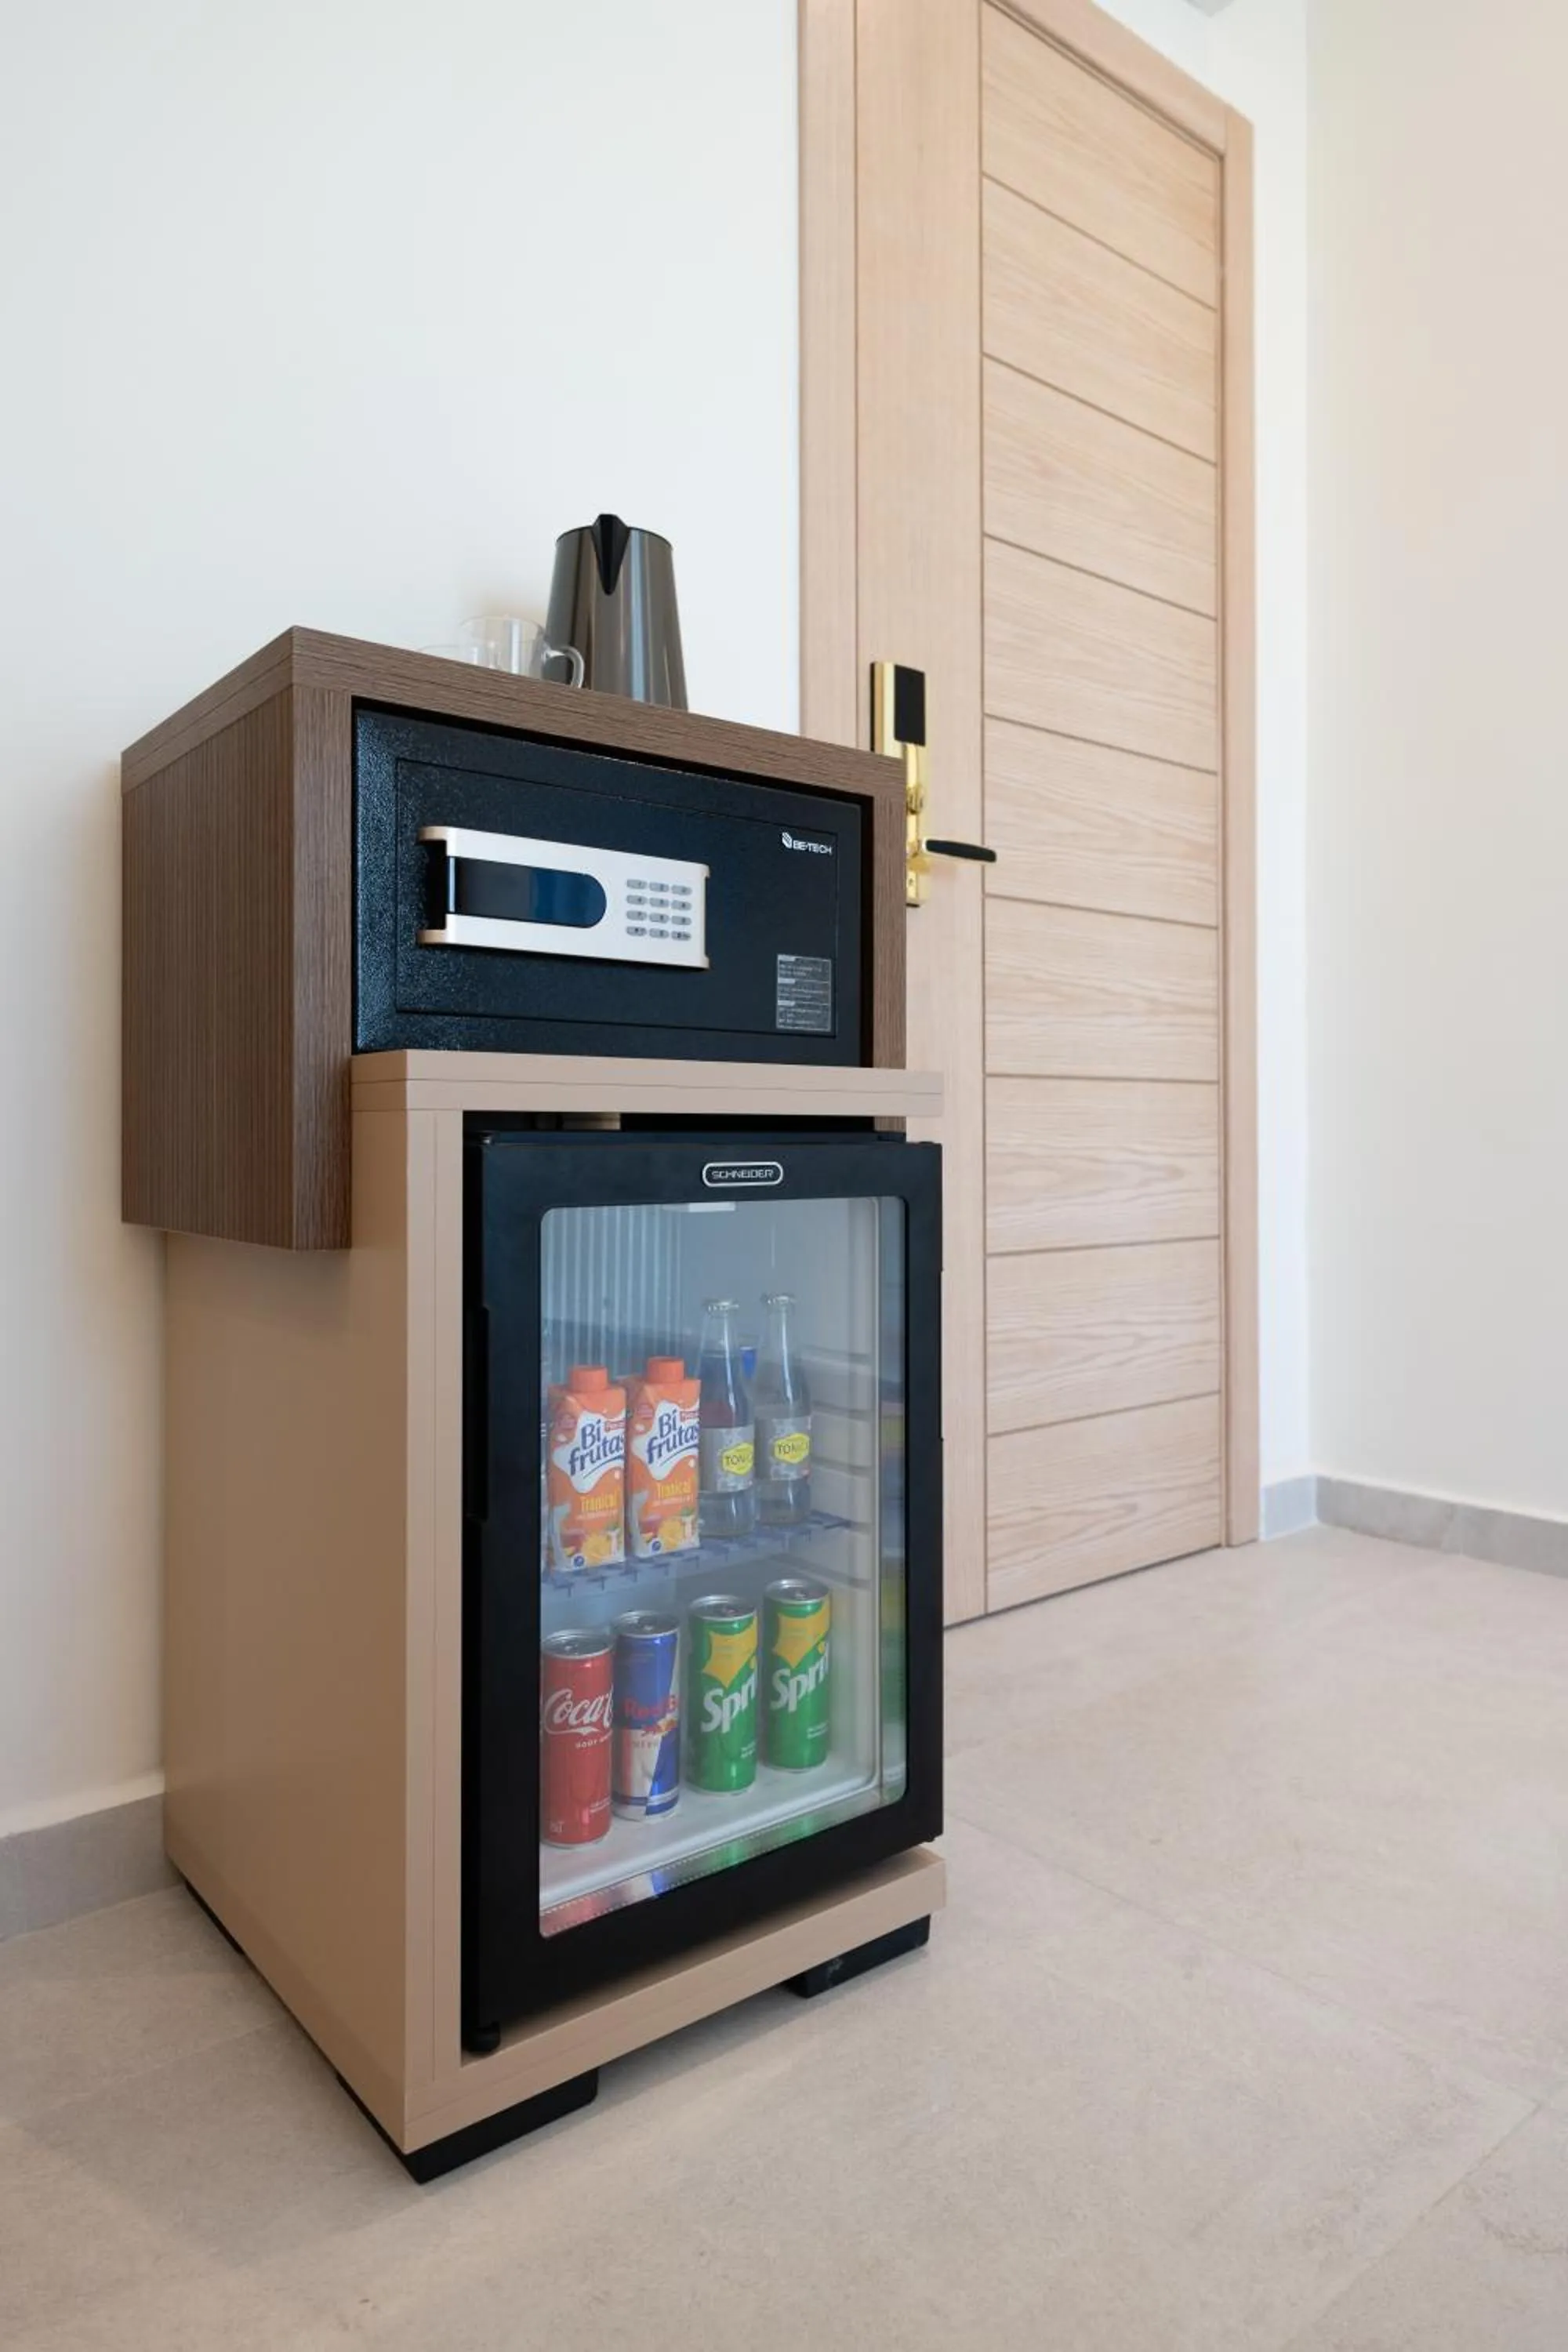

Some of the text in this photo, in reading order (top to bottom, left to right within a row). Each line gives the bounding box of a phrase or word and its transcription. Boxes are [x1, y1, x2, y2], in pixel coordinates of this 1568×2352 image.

[711, 1169, 774, 1180] SCHNEIDER
[581, 1418, 601, 1450] Bi
[659, 1409, 677, 1439] Bi
